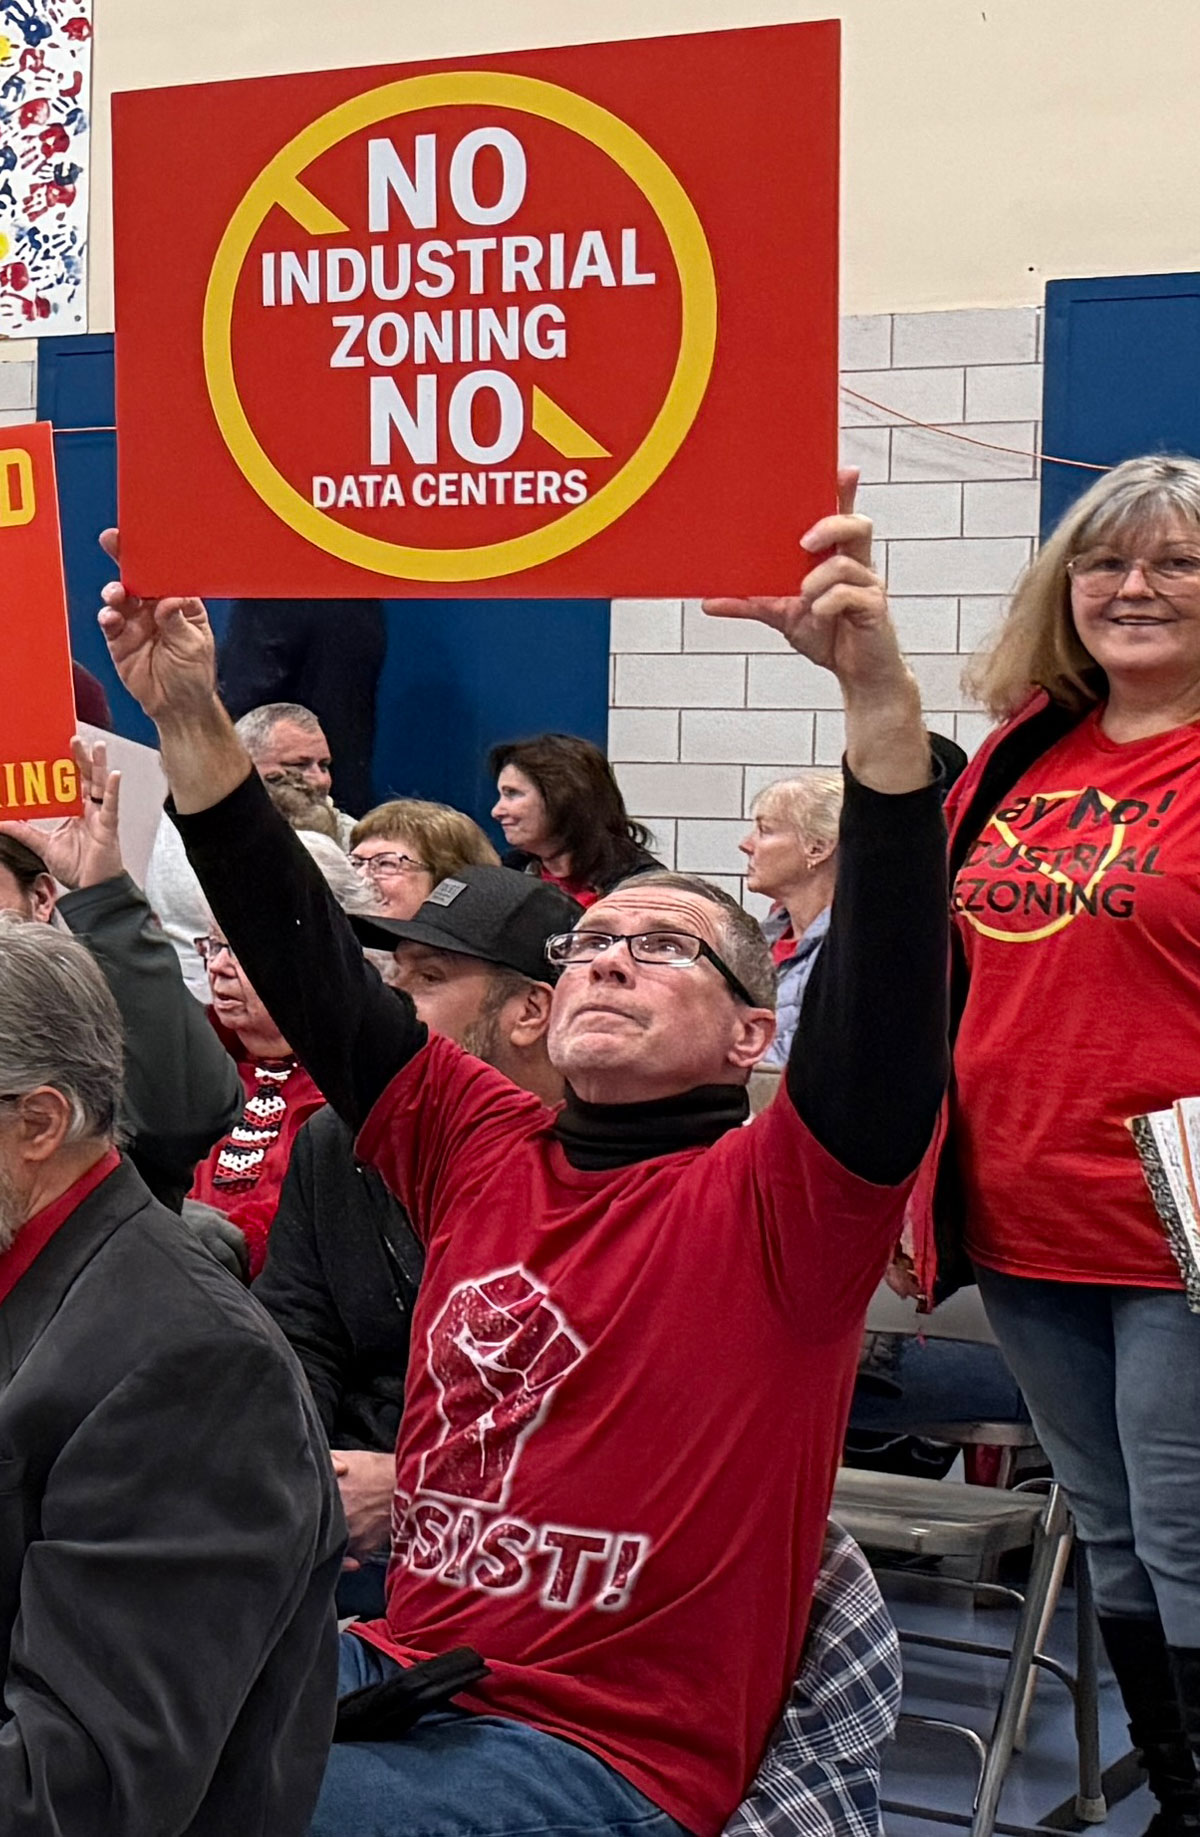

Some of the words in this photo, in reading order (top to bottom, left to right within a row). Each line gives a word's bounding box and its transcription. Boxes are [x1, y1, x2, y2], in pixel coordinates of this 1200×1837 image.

[368, 127, 527, 233] NO
[261, 228, 656, 307] INDUSTRIAL
[329, 303, 567, 368] ZONING
[369, 370, 524, 466] NO
[312, 474, 406, 509] DATA
[411, 469, 588, 507] CENTERS
